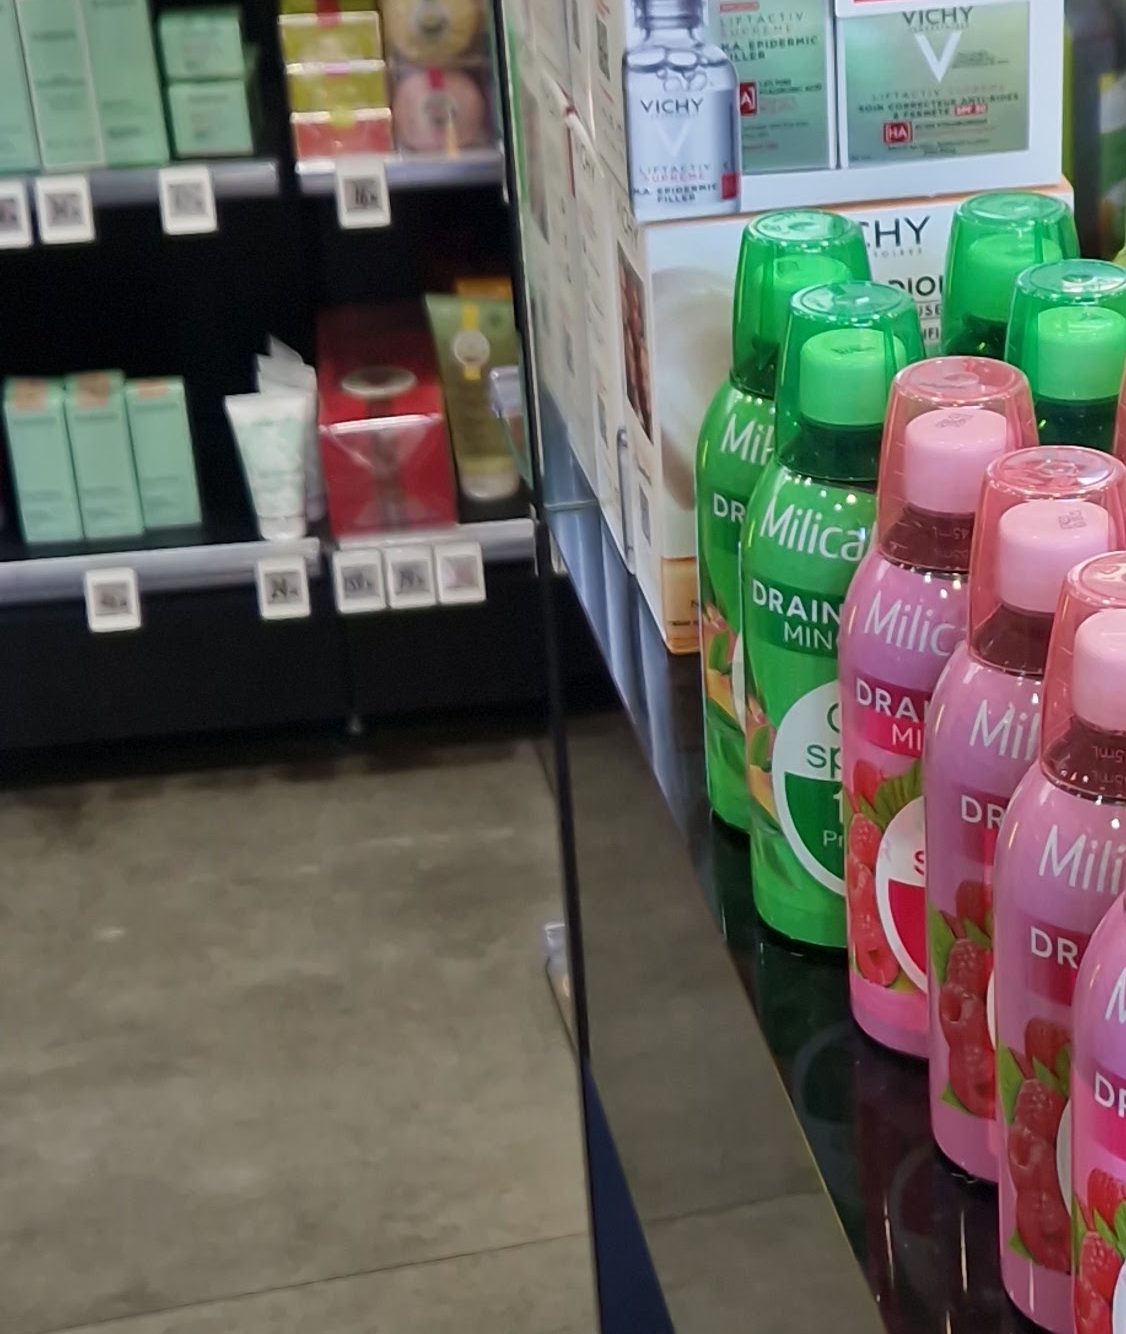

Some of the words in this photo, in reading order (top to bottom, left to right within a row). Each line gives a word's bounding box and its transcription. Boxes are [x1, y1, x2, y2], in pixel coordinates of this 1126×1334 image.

[901, 5, 974, 26] VICHY
[727, 52, 767, 63] ILLER
[639, 97, 704, 115] VICHY
[760, 495, 866, 563] Milica
[750, 578, 842, 624] DRAIN
[863, 590, 957, 657] Milic
[1038, 824, 1126, 897] Mili
